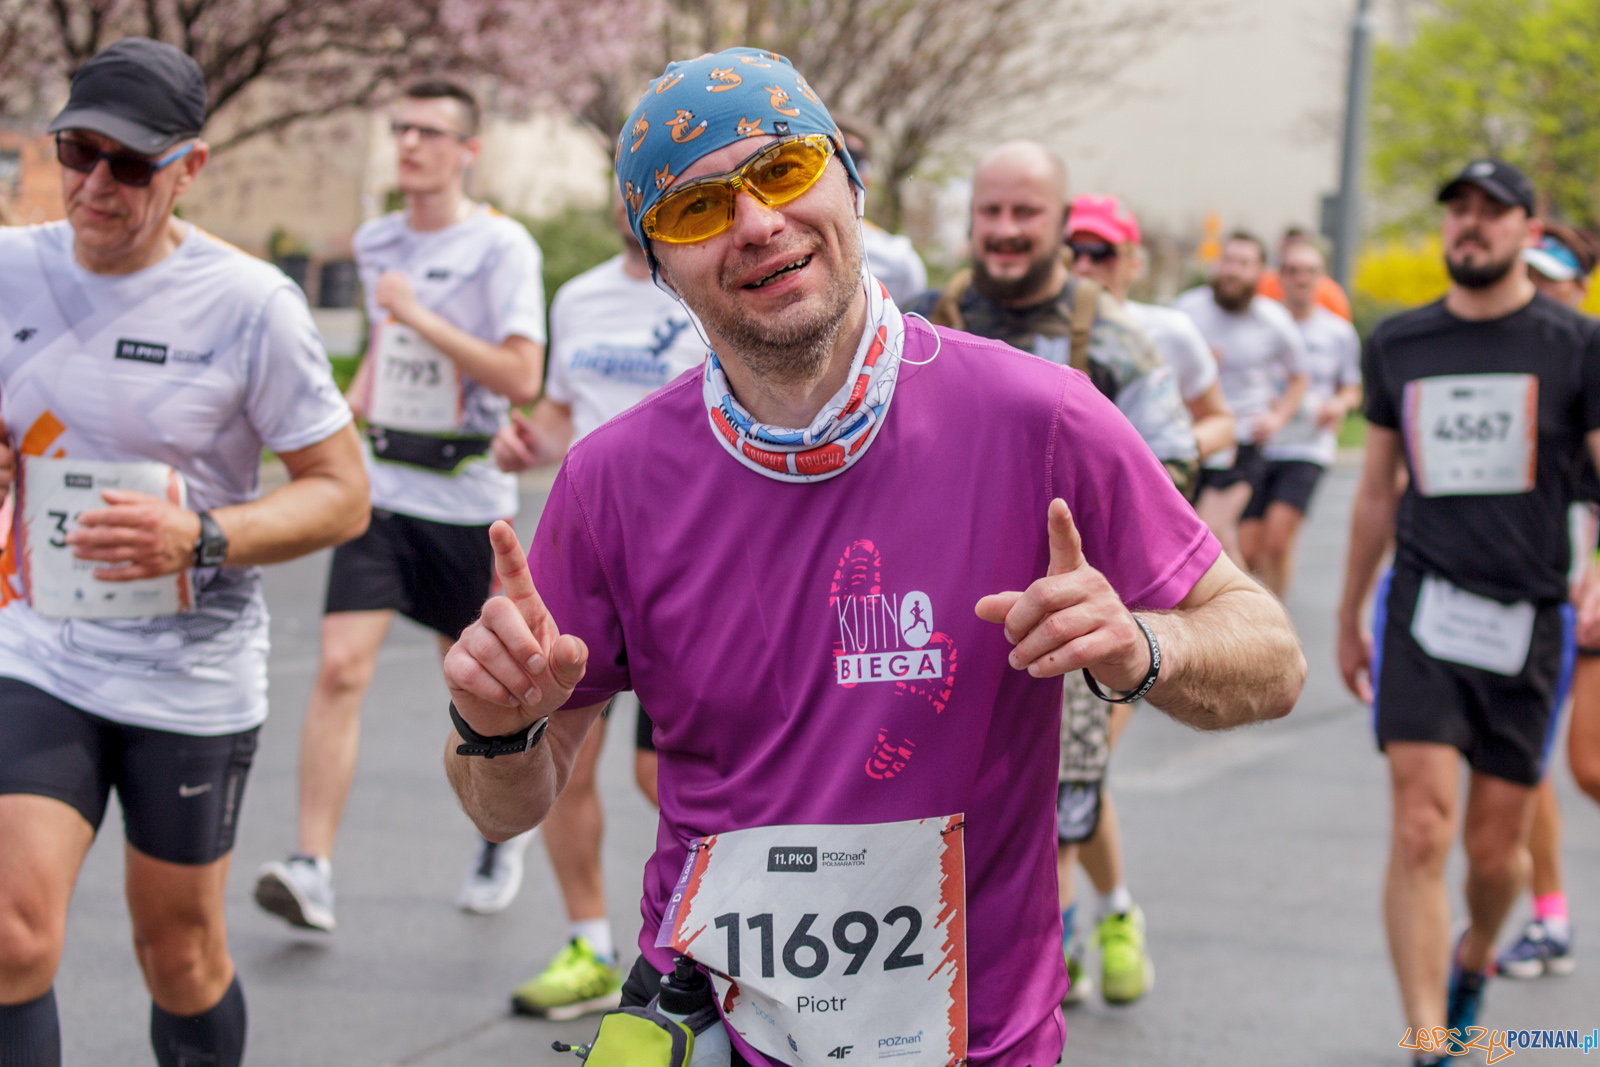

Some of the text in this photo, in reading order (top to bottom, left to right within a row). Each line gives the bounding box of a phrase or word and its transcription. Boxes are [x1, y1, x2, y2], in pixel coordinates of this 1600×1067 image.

[1433, 413, 1513, 441] 4567
[798, 452, 841, 468] TRUCHT
[836, 590, 934, 653] KUTNO
[840, 653, 937, 680] BIEGA
[672, 893, 682, 903] D
[713, 905, 924, 979] 11692
[796, 995, 847, 1014] Piotr
